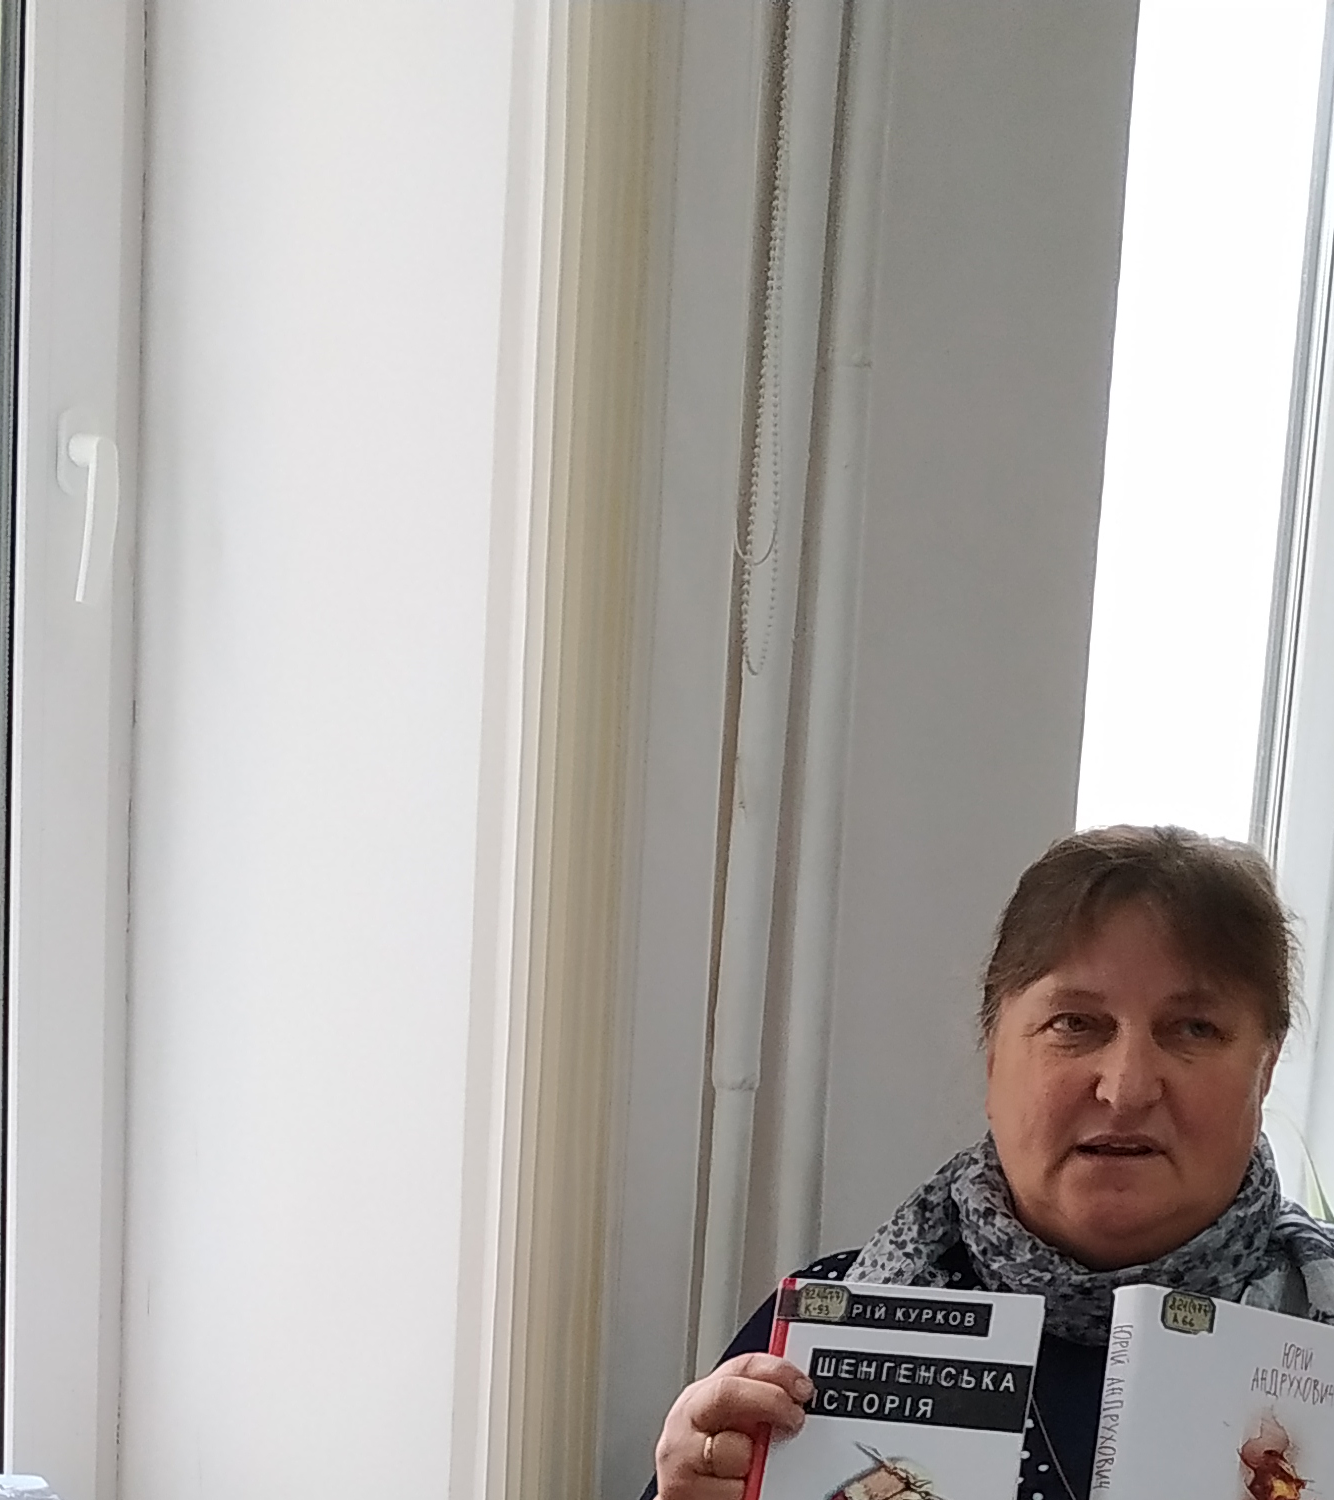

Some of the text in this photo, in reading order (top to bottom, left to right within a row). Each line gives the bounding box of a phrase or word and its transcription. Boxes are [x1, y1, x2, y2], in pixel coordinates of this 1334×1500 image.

[851, 1303, 976, 1326] РІЙ КУРКОВ
[1110, 1324, 1134, 1366] ЮРІЙ
[1281, 1342, 1314, 1371] ЮРІЙ
[815, 1355, 1016, 1393] ШЕНГЕНСЬКА
[811, 1389, 934, 1419] ІСТОРІЯ
[1091, 1377, 1125, 1490] АНДРУХОВИЧ
